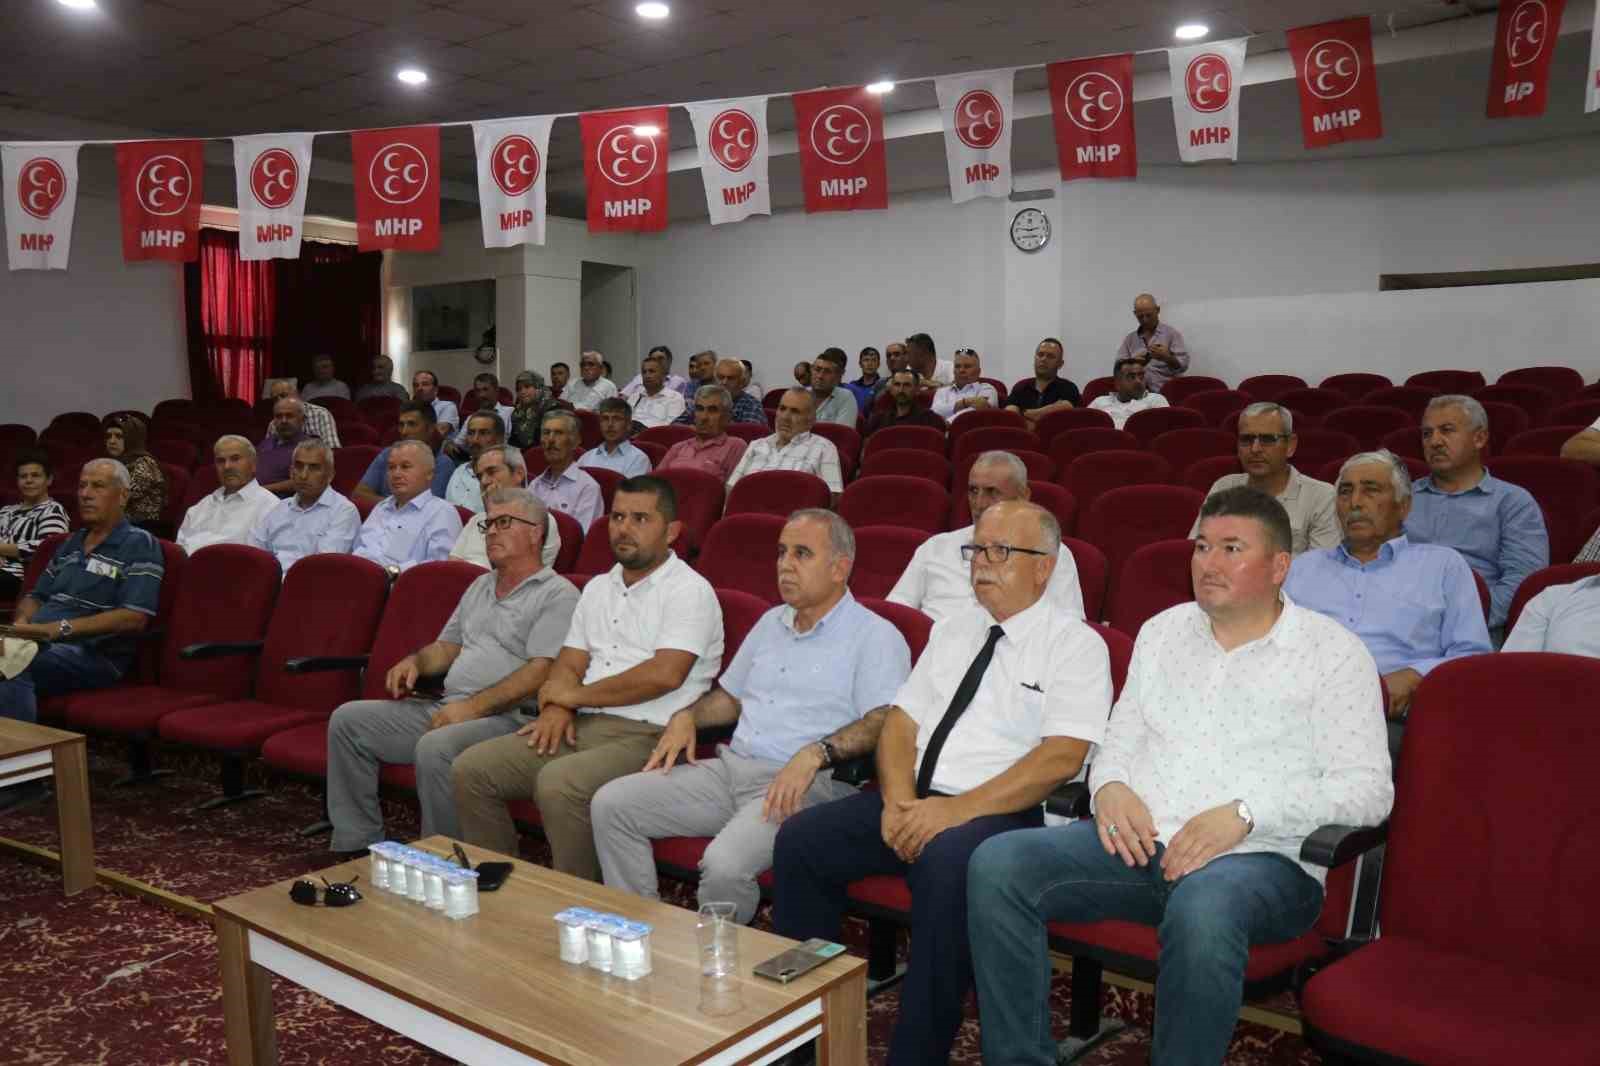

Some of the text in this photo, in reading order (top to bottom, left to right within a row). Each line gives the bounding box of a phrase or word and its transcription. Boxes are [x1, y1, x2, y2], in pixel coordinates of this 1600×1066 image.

[1313, 109, 1361, 132] MHP
[1190, 127, 1231, 146] MHP
[1077, 144, 1120, 163] MHP
[965, 163, 1000, 184] MHP
[722, 182, 756, 206] MHP
[821, 177, 867, 196] MHP
[604, 199, 652, 217] MHP
[375, 218, 422, 236] MHP
[500, 211, 533, 231] MHP
[141, 230, 185, 249] MHP
[257, 224, 292, 242] MHP
